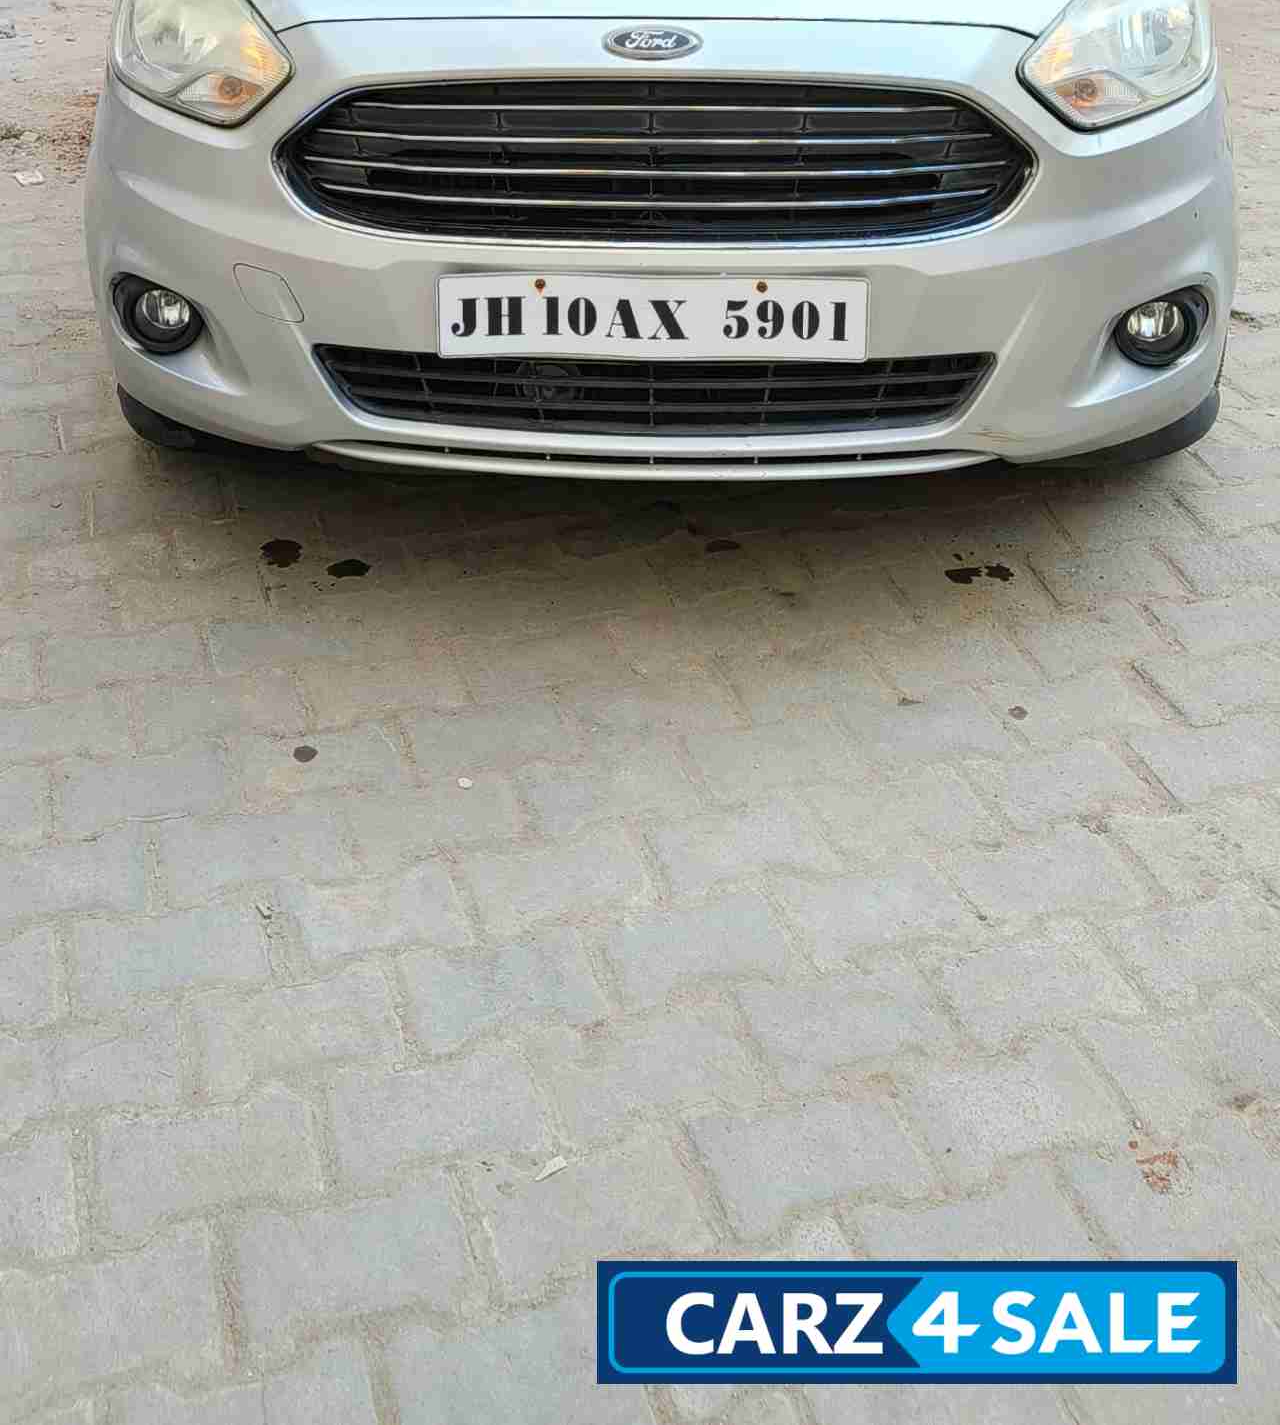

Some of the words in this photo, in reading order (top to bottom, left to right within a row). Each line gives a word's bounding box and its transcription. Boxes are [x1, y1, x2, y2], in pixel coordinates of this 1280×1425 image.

[625, 31, 677, 48] Ford
[451, 296, 526, 337] JH
[723, 299, 848, 342] 5901
